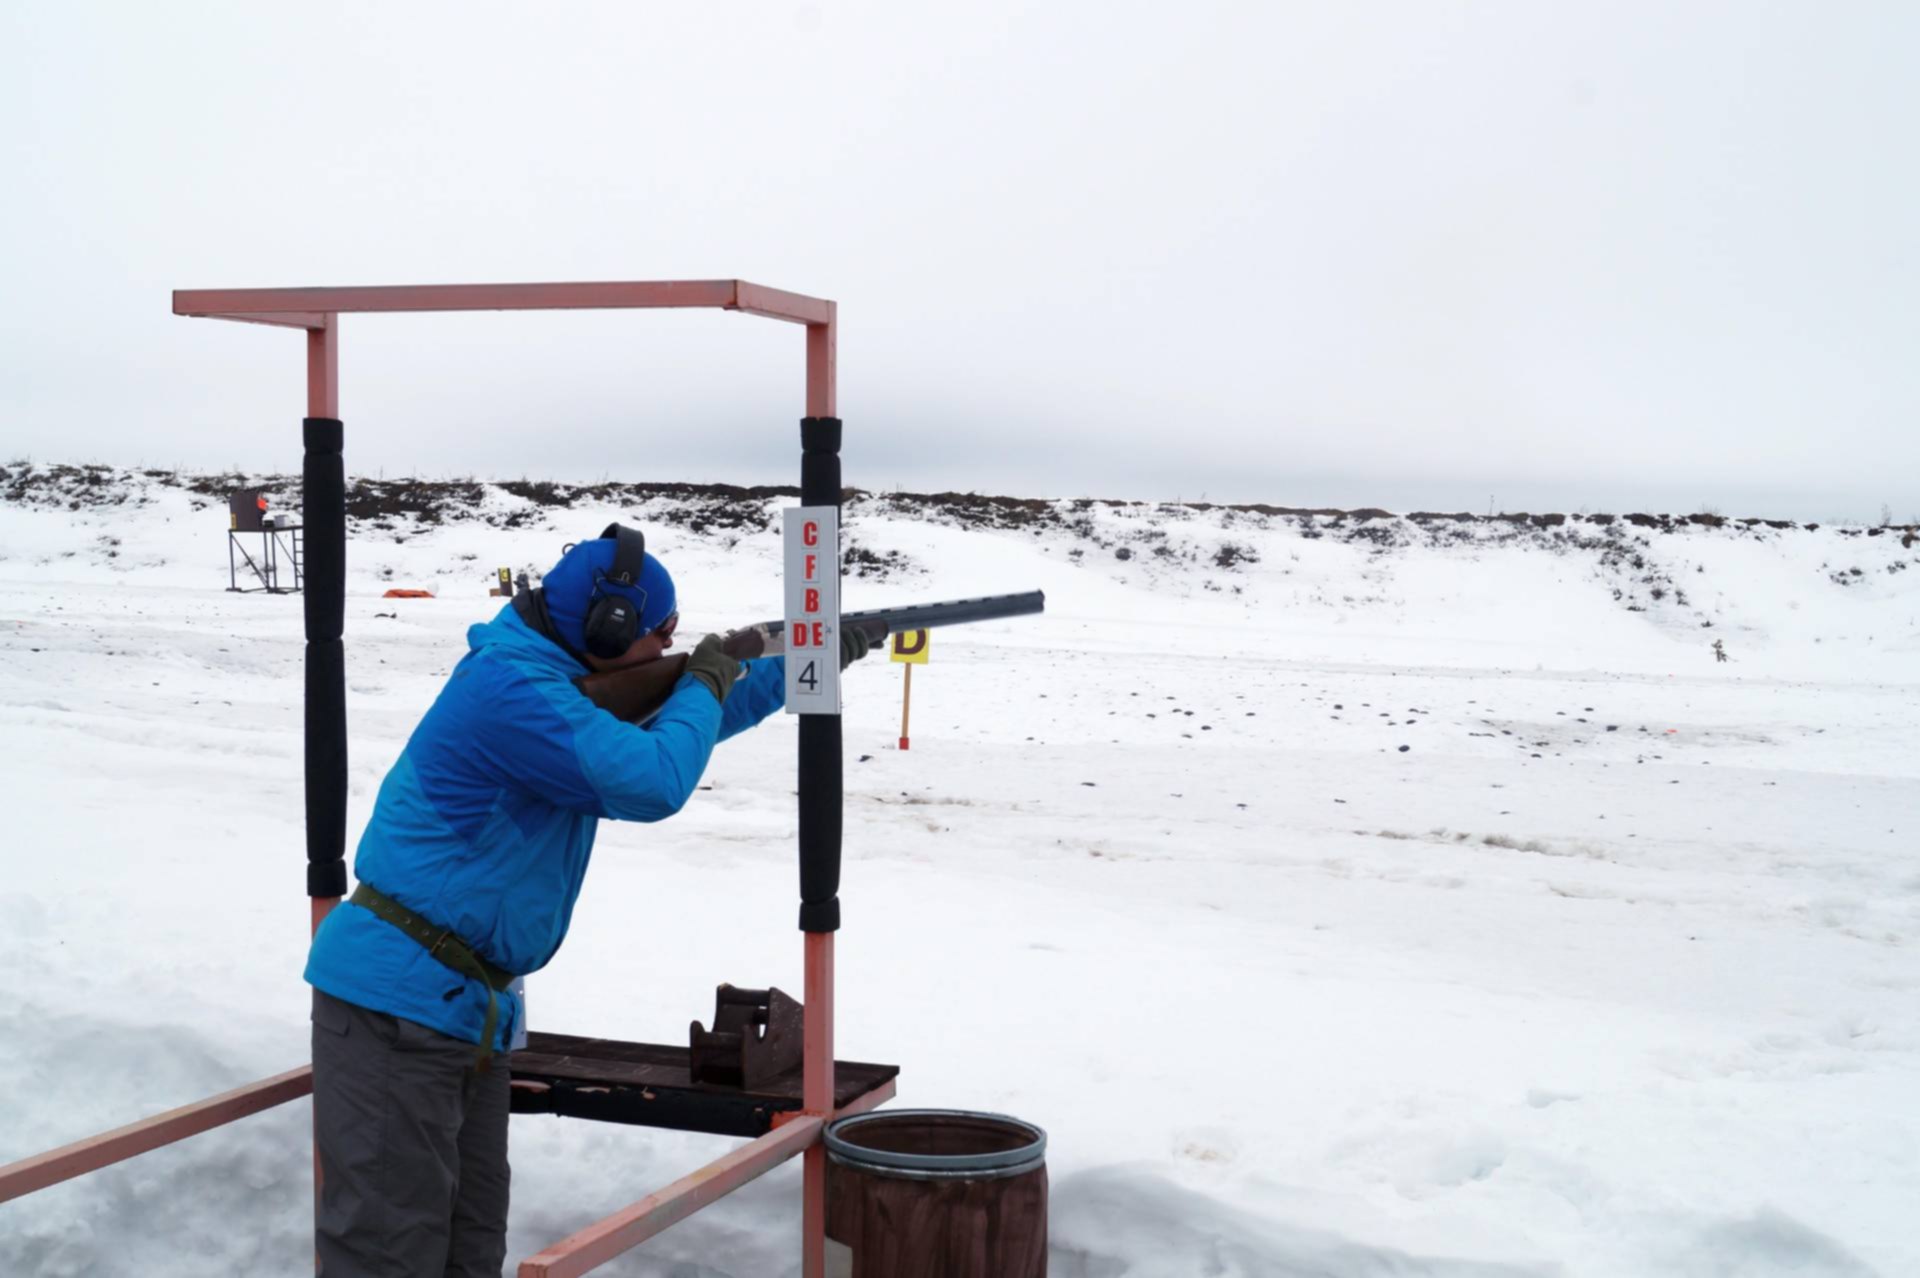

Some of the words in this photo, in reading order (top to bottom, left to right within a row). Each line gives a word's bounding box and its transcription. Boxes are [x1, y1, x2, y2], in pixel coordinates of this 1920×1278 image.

[803, 521, 817, 546] C
[805, 554, 816, 579] F
[805, 588, 819, 613] B
[793, 622, 823, 647] DE
[894, 629, 926, 655] D
[798, 660, 818, 691] 4
